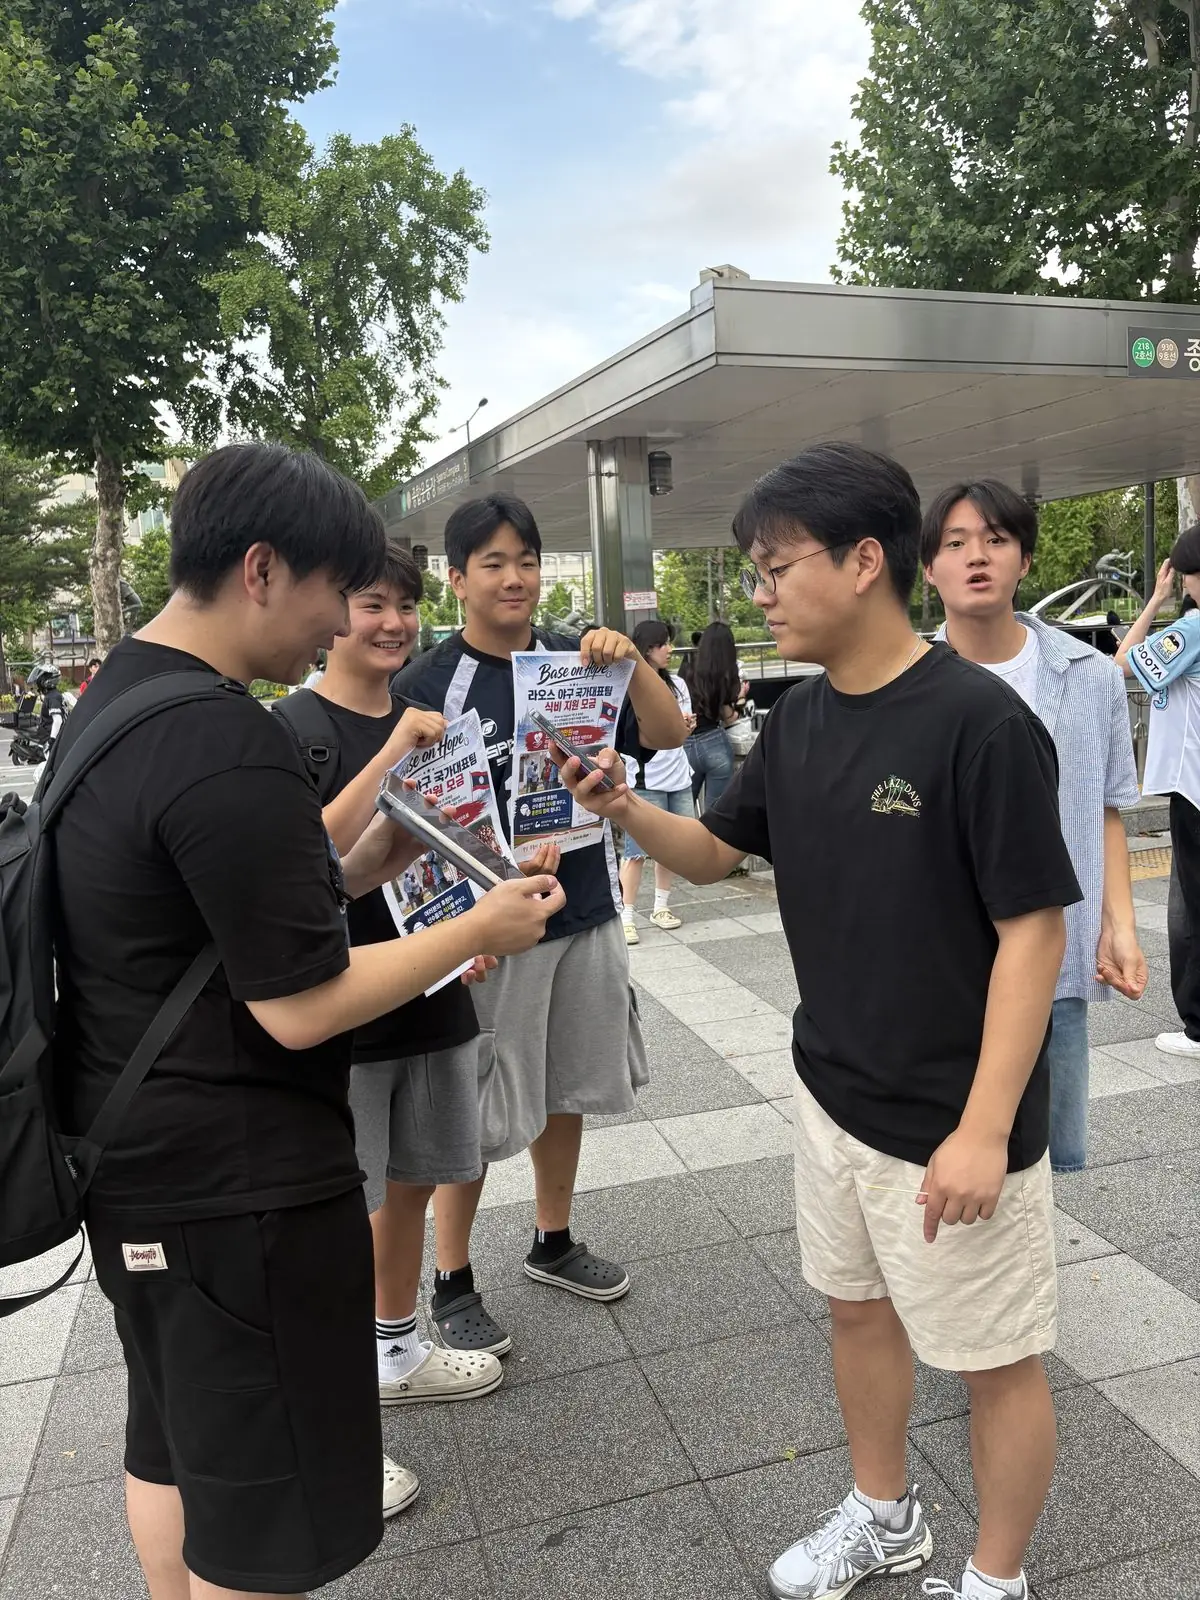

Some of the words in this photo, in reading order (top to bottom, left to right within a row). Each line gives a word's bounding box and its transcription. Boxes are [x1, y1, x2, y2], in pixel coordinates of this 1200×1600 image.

[1137, 342, 1150, 350] 218
[1161, 343, 1174, 351] 930
[1135, 351, 1153, 360] 2호선
[1159, 352, 1176, 361] 9호선
[1137, 644, 1163, 680] DOOTA
[538, 663, 568, 682] Base
[571, 667, 582, 677] on
[584, 662, 608, 680] Hope
[528, 689, 555, 701] 라오스
[558, 688, 574, 700] 야구
[575, 686, 613, 699] 국가대표팀
[545, 701, 562, 713] 식비
[564, 700, 580, 712] 지원
[581, 698, 597, 709] 모금
[422, 747, 435, 763] on
[437, 732, 464, 760] Hope
[434, 752, 477, 782] 국가대표팀
[446, 773, 464, 792] 모금
[871, 784, 884, 801] THE
[883, 778, 906, 790] LAZY
[904, 783, 921, 807] DAYS
